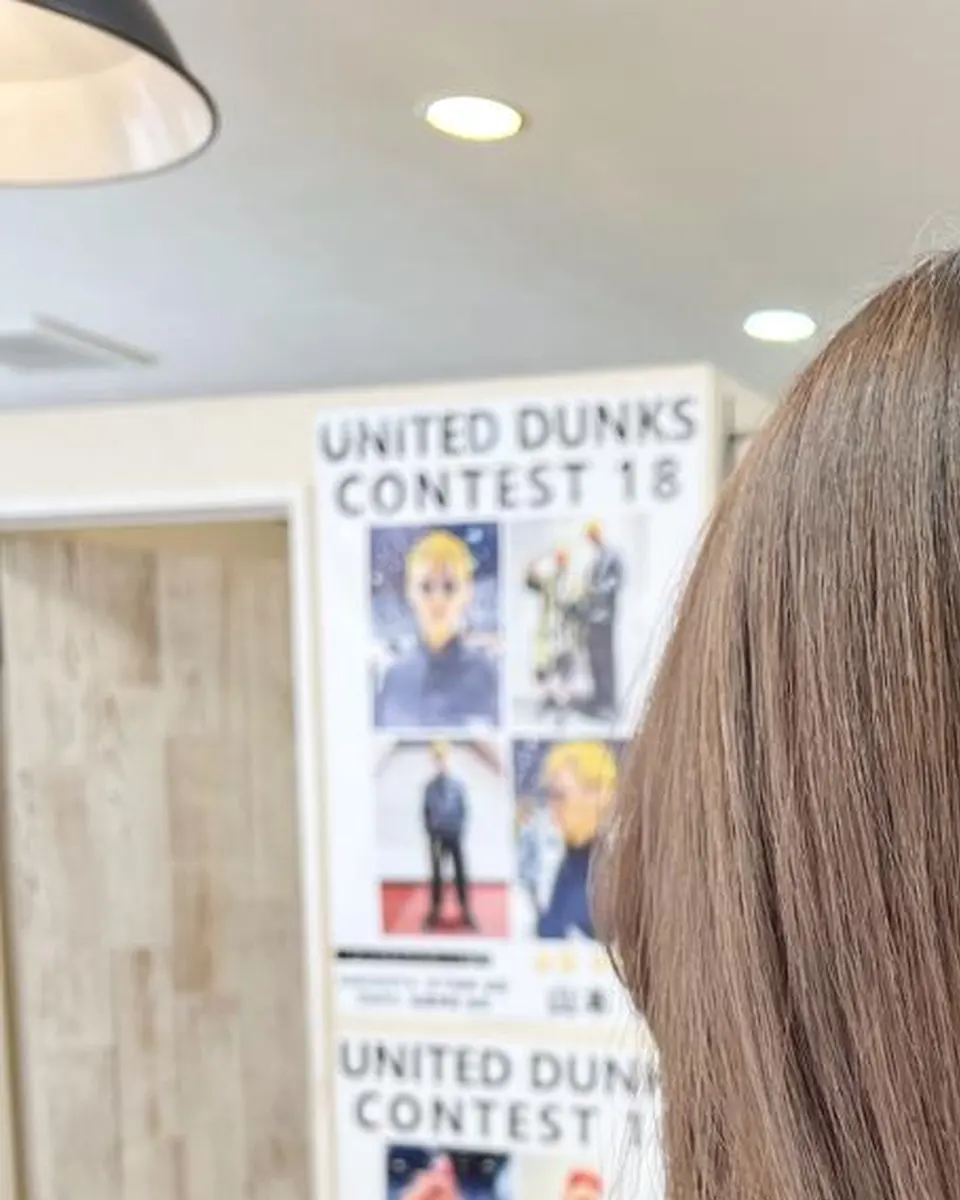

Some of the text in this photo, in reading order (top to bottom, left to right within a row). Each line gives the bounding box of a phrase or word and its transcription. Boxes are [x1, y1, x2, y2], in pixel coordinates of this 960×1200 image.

[319, 396, 699, 464] UNITED DUNKS
[336, 456, 682, 515] CONTEST 18
[340, 1042, 513, 1087] UNITED
[354, 1090, 600, 1145] CONTEST
